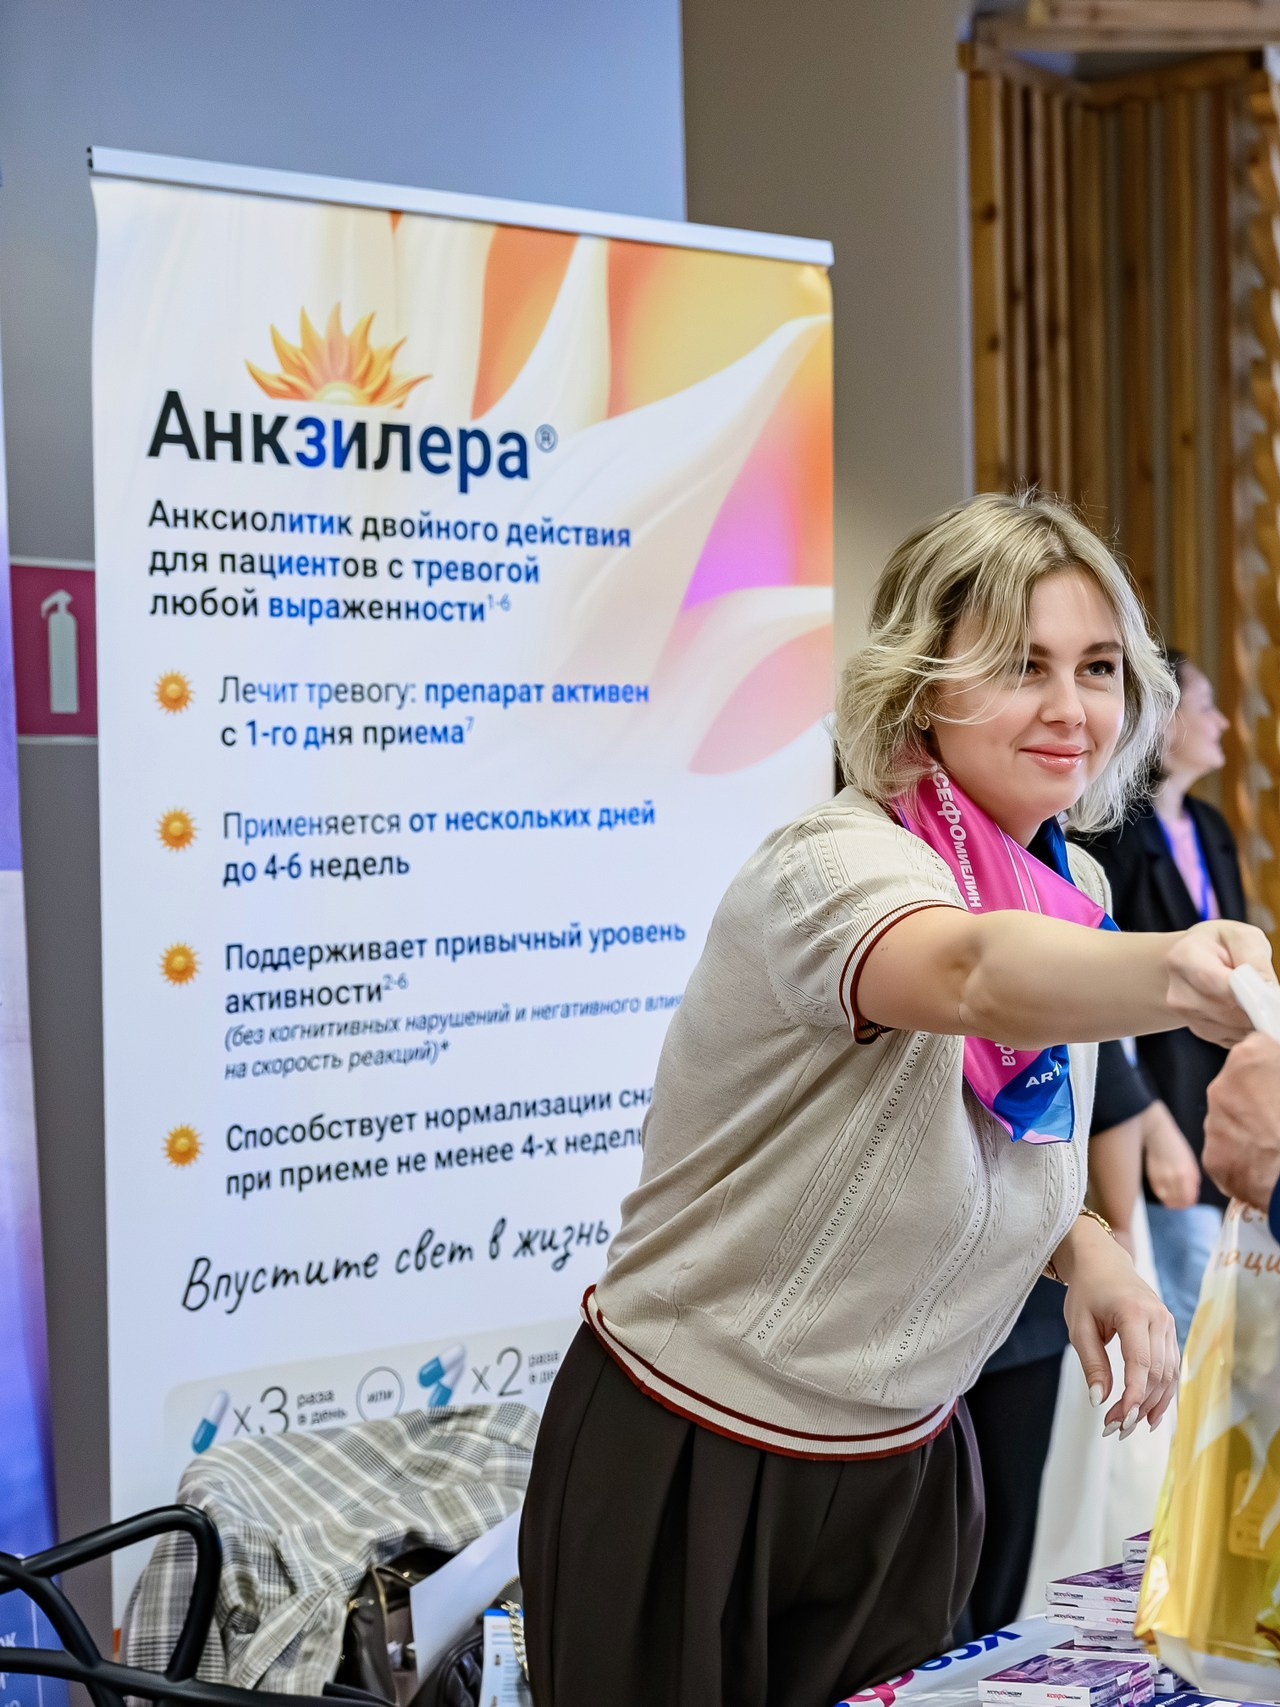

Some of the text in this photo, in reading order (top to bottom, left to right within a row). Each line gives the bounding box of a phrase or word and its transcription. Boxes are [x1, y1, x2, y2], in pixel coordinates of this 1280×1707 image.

[148, 499, 631, 548] Анксиолитик двойного действия
[148, 548, 539, 587] для пациентов с тревогой
[150, 587, 258, 617] любой
[219, 675, 649, 710] Лечит тревогу: препарат активен
[221, 726, 236, 747] с
[246, 720, 297, 747] 1-го
[303, 726, 352, 750] дня
[223, 800, 655, 846] Применяется от нескольких дней
[222, 852, 411, 887] до 4-6 недель
[225, 922, 686, 973] Поддерживает привычный уровень
[224, 1024, 265, 1052] (без
[268, 1017, 401, 1043] когнитивных
[405, 1003, 511, 1034] нарушений
[515, 1008, 527, 1022] и
[531, 997, 641, 1021] негативного
[225, 1062, 248, 1080] на
[251, 1053, 343, 1078] скорость
[226, 1112, 417, 1152] Способствует
[425, 1092, 612, 1133] нормализации
[226, 1170, 271, 1200] при
[280, 1157, 389, 1192] приеме
[397, 1152, 427, 1174] не
[434, 1142, 514, 1170] менее
[521, 1134, 557, 1158] 4-х
[181, 1217, 610, 1315] Впустите свет в жизнь
[529, 1373, 537, 1385] в
[297, 1413, 307, 1426] в
